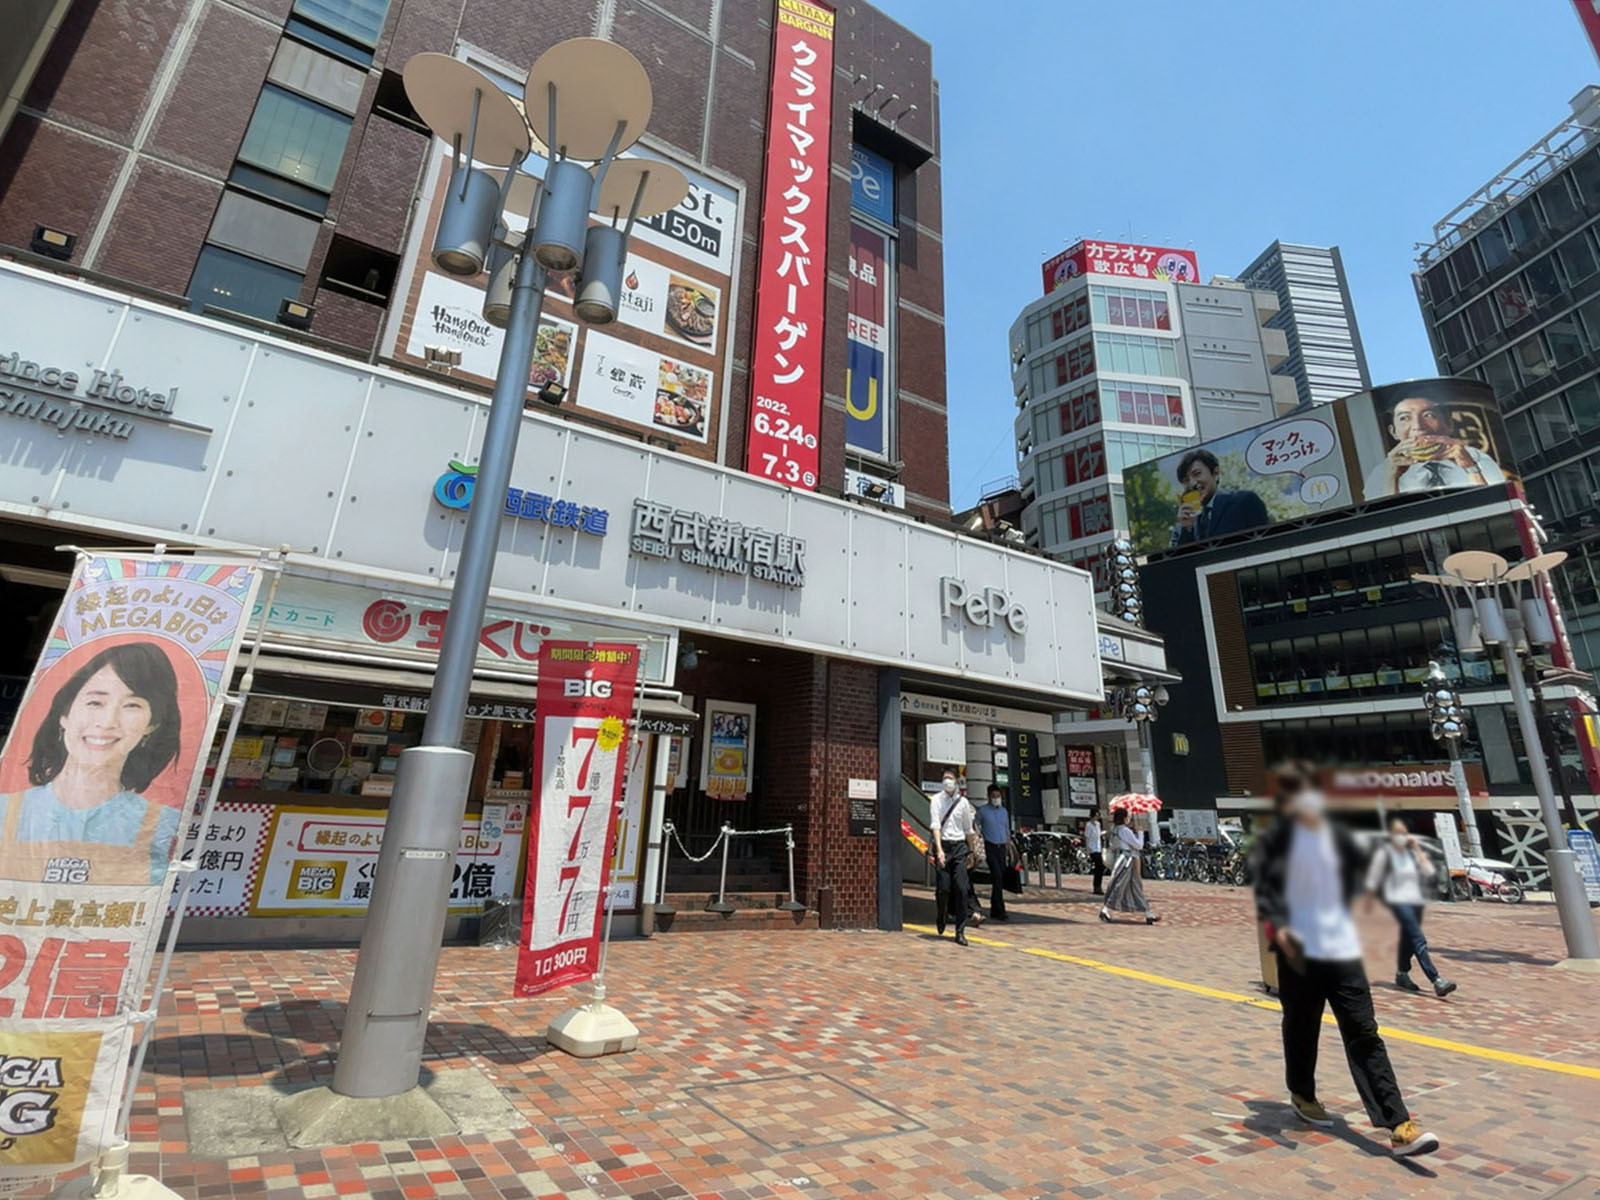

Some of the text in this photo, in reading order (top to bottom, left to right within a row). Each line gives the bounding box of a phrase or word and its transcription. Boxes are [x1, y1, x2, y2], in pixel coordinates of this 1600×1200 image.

[779, 0, 834, 26] CLIMAX
[780, 12, 834, 40] BARGAIN
[772, 40, 818, 385] クライマックスバーゲン
[655, 212, 718, 253] 150m
[1086, 242, 1157, 263] カラオケ
[1093, 259, 1149, 278] 歌広場
[86, 368, 180, 416] Hotel
[756, 396, 791, 416] 2022.
[0, 388, 136, 441] Shinjuku
[504, 487, 610, 537] 西武鉄道
[631, 497, 808, 574] 西武新宿駅
[631, 538, 805, 588] SEIBU SHINJUKU STATION
[76, 584, 229, 625] 縁起のよい日は
[939, 576, 1030, 636] PePe
[80, 606, 209, 644] MEGA BIG
[563, 677, 613, 699] BIG
[1018, 733, 1032, 798] METRO
[43, 867, 89, 883] BIG
[47, 857, 91, 870] MEGA
[299, 867, 337, 878] MEGA
[296, 876, 337, 892] BIG
[0, 1055, 64, 1088] GA
[0, 1089, 59, 1136] G
